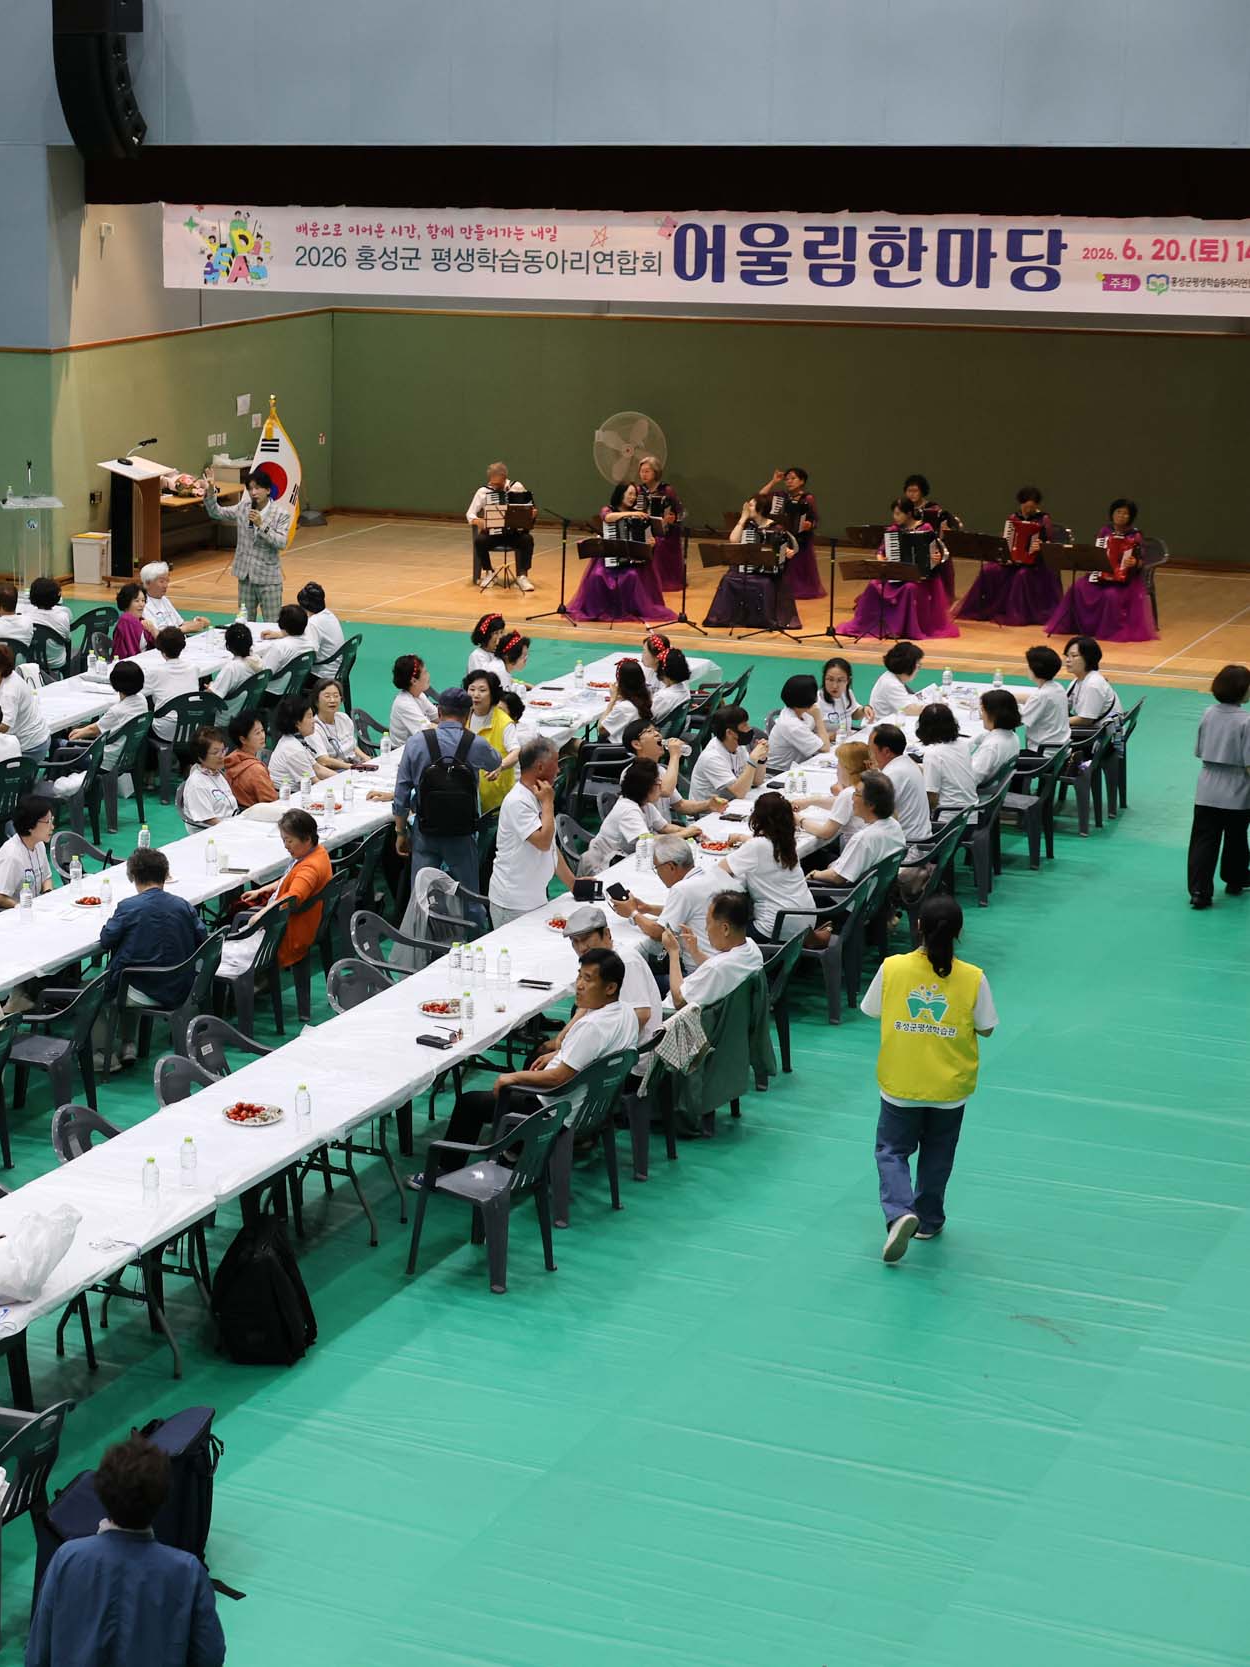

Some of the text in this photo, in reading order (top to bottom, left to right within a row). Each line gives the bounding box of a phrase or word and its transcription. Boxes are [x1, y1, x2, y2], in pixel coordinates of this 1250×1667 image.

[348, 222, 386, 239] 이어온
[391, 223, 421, 241] 시간,
[426, 223, 454, 240] 함께
[459, 223, 526, 242] 만들어가는
[530, 224, 558, 243] 내일
[295, 244, 663, 276] 2026 홍성군 평생학습동아리연합회
[672, 222, 1068, 292] 어울림한마당
[1082, 247, 1118, 261] 2026.
[1122, 238, 1143, 261] 6.
[1151, 238, 1230, 263] 20.(토)
[1109, 277, 1132, 290] 주최
[1171, 277, 1250, 290] 홍성군평생학습동아리연
